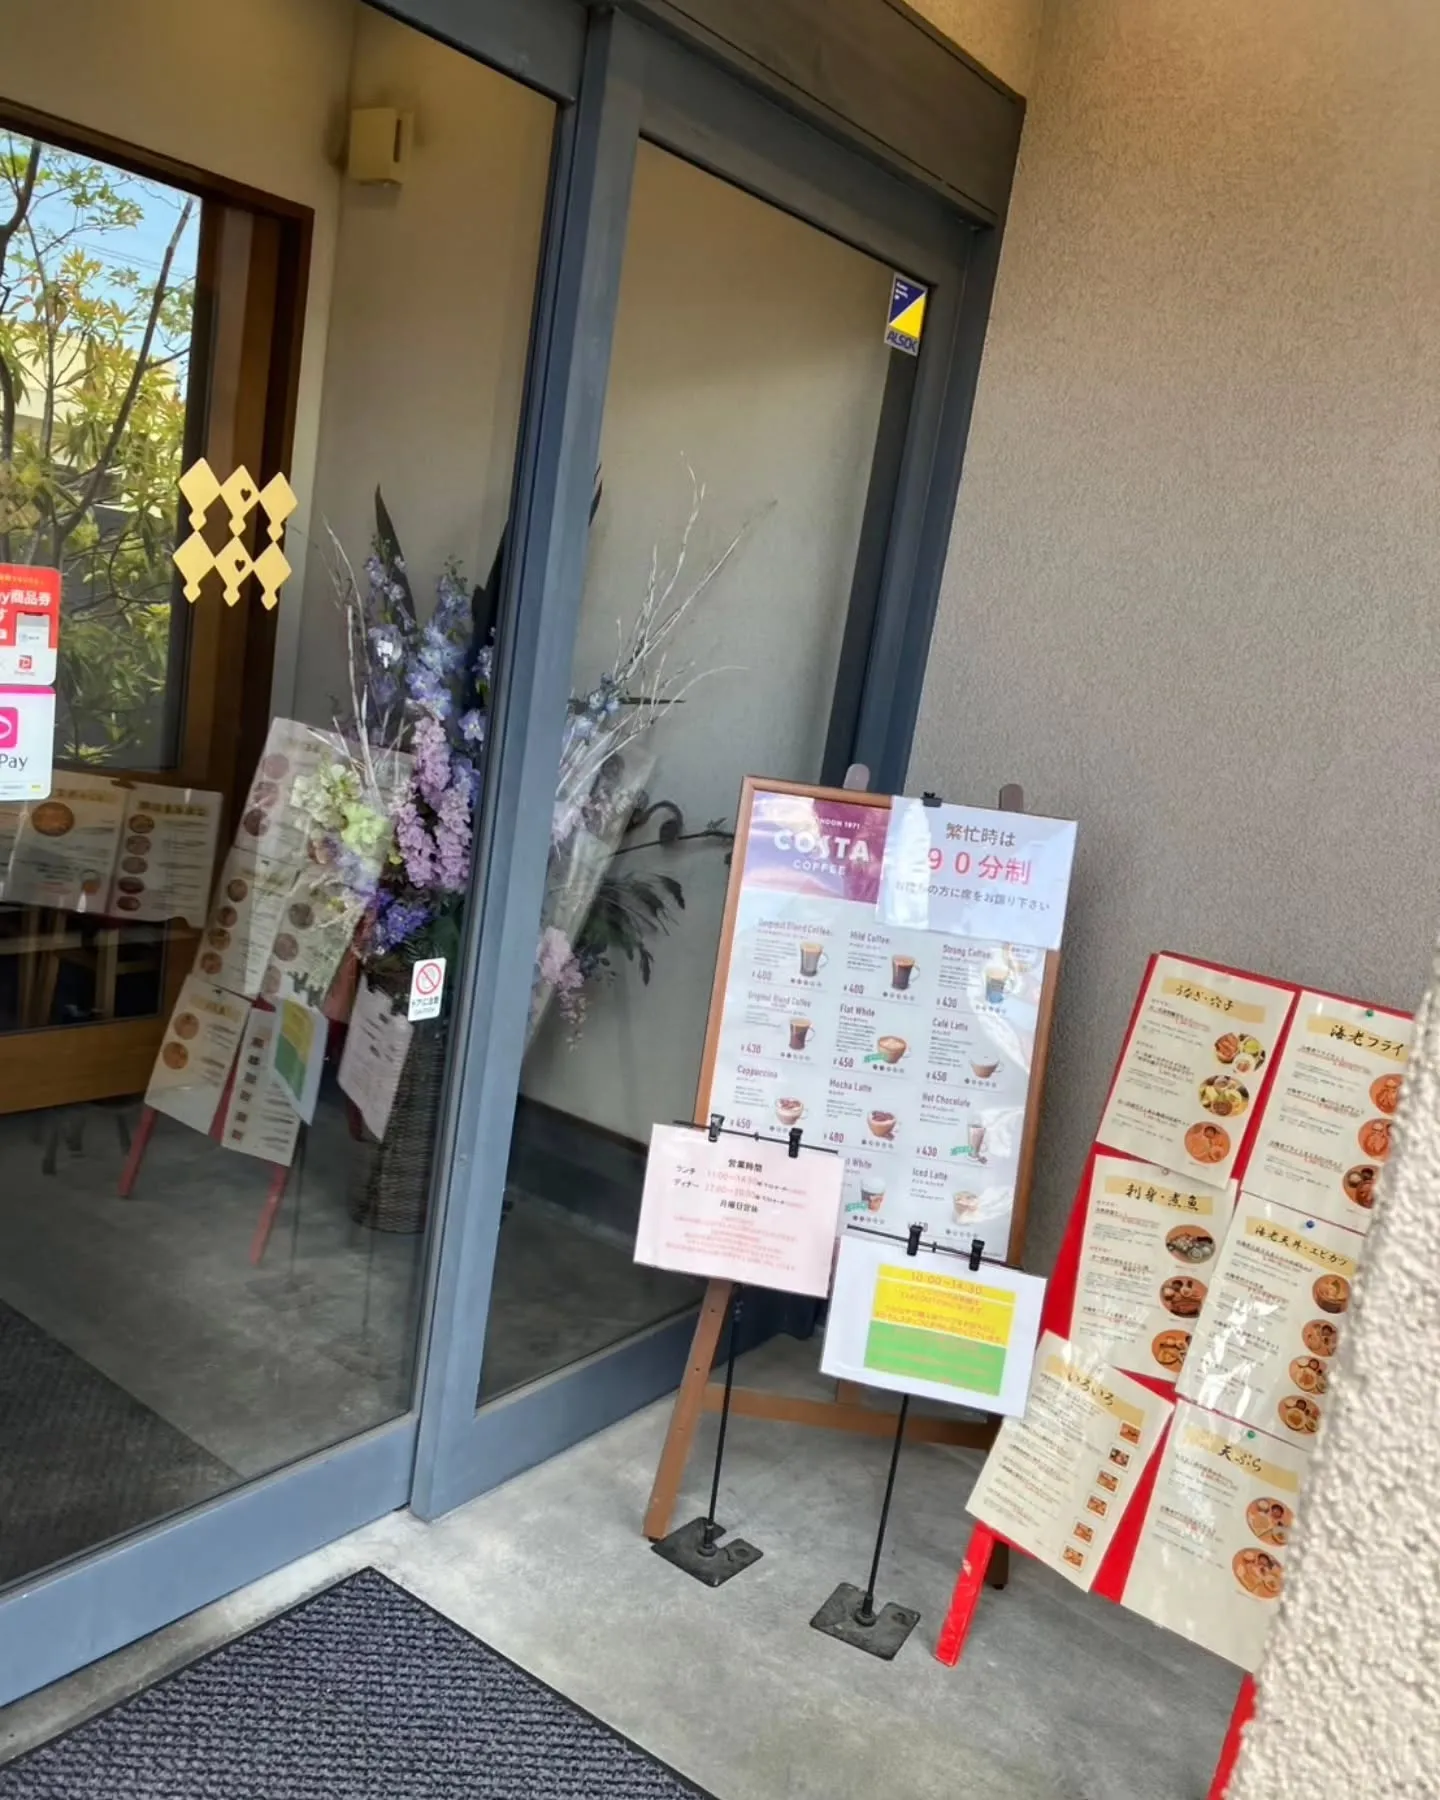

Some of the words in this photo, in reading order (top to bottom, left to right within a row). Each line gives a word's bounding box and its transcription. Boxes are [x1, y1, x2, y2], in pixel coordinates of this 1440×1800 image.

[945, 821, 1016, 848] 繁忙時は
[773, 829, 870, 863] COSTA
[792, 859, 846, 876] COFFEE
[867, 932, 890, 944] Coffee
[839, 1003, 854, 1014] Flat
[855, 1004, 876, 1017] White
[1329, 1024, 1405, 1057] 海老フライ
[676, 1165, 696, 1175] ランチ
[728, 1158, 763, 1173] 営業時間
[673, 1178, 700, 1189] ディナー
[1067, 1370, 1115, 1406] いろいろ
[1217, 1444, 1262, 1473] 天ぷら
